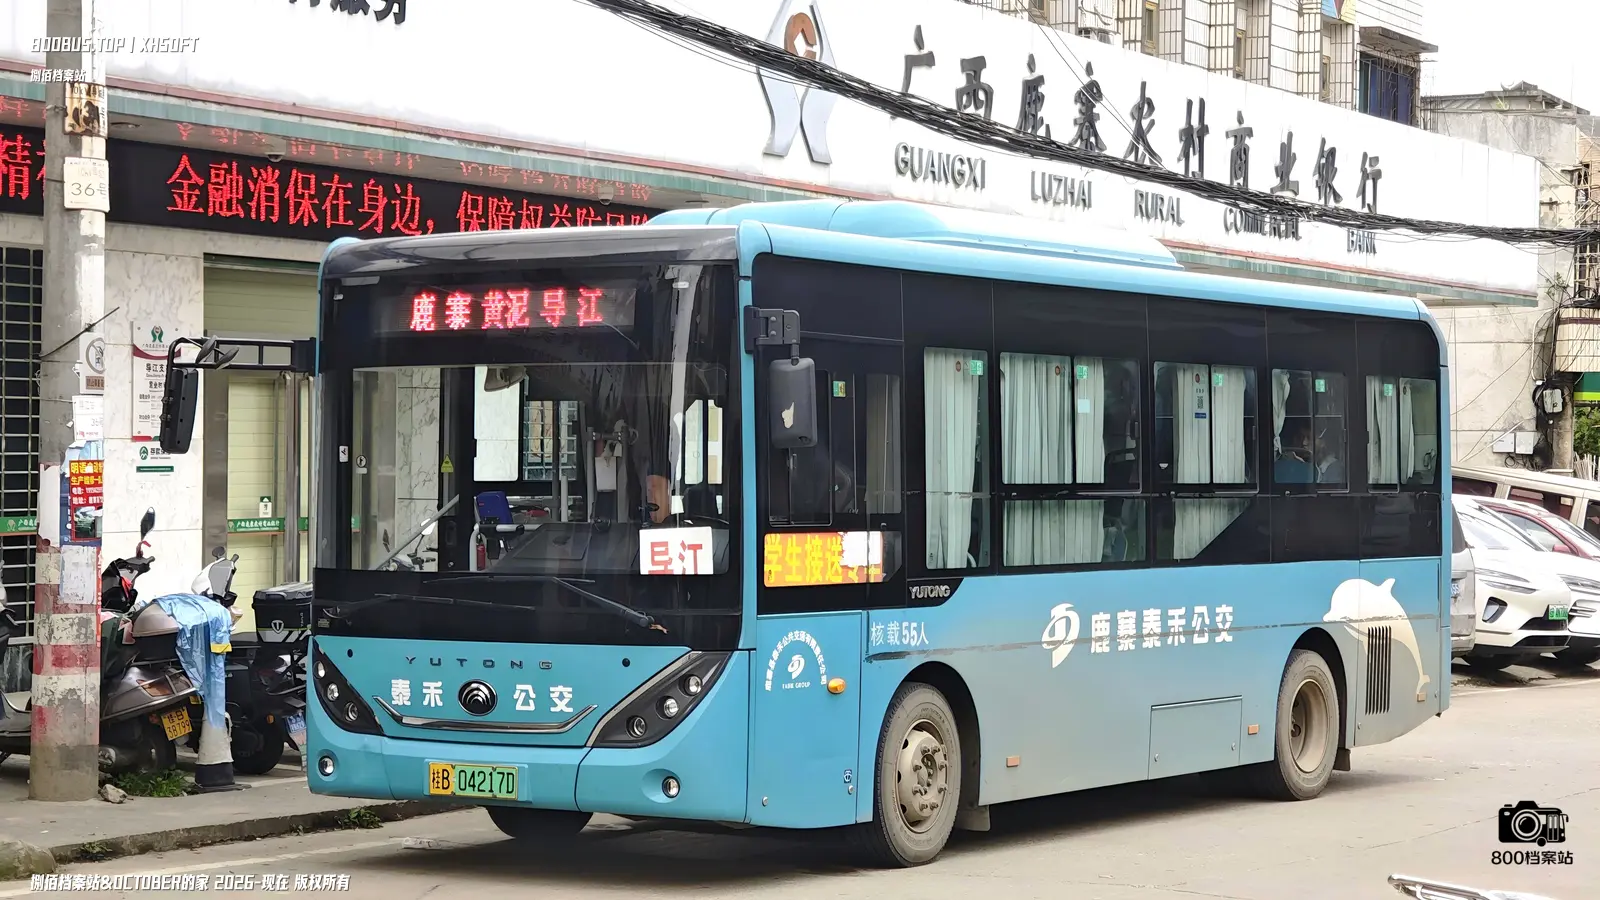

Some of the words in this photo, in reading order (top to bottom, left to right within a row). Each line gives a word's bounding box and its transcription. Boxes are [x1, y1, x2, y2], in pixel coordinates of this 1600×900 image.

[890, 25, 1384, 215] 广西鹿寨农村商业银行
[0, 134, 46, 200] 精
[895, 141, 987, 191] GUANGXI
[1030, 169, 1094, 210] LUZHAI
[1134, 188, 1186, 228] RURAL
[909, 584, 951, 599] YUTONG
[871, 620, 929, 647] 核载55人
[1091, 604, 1234, 654] 鹿寨泰禾公交
[405, 656, 553, 670] YUTONG
